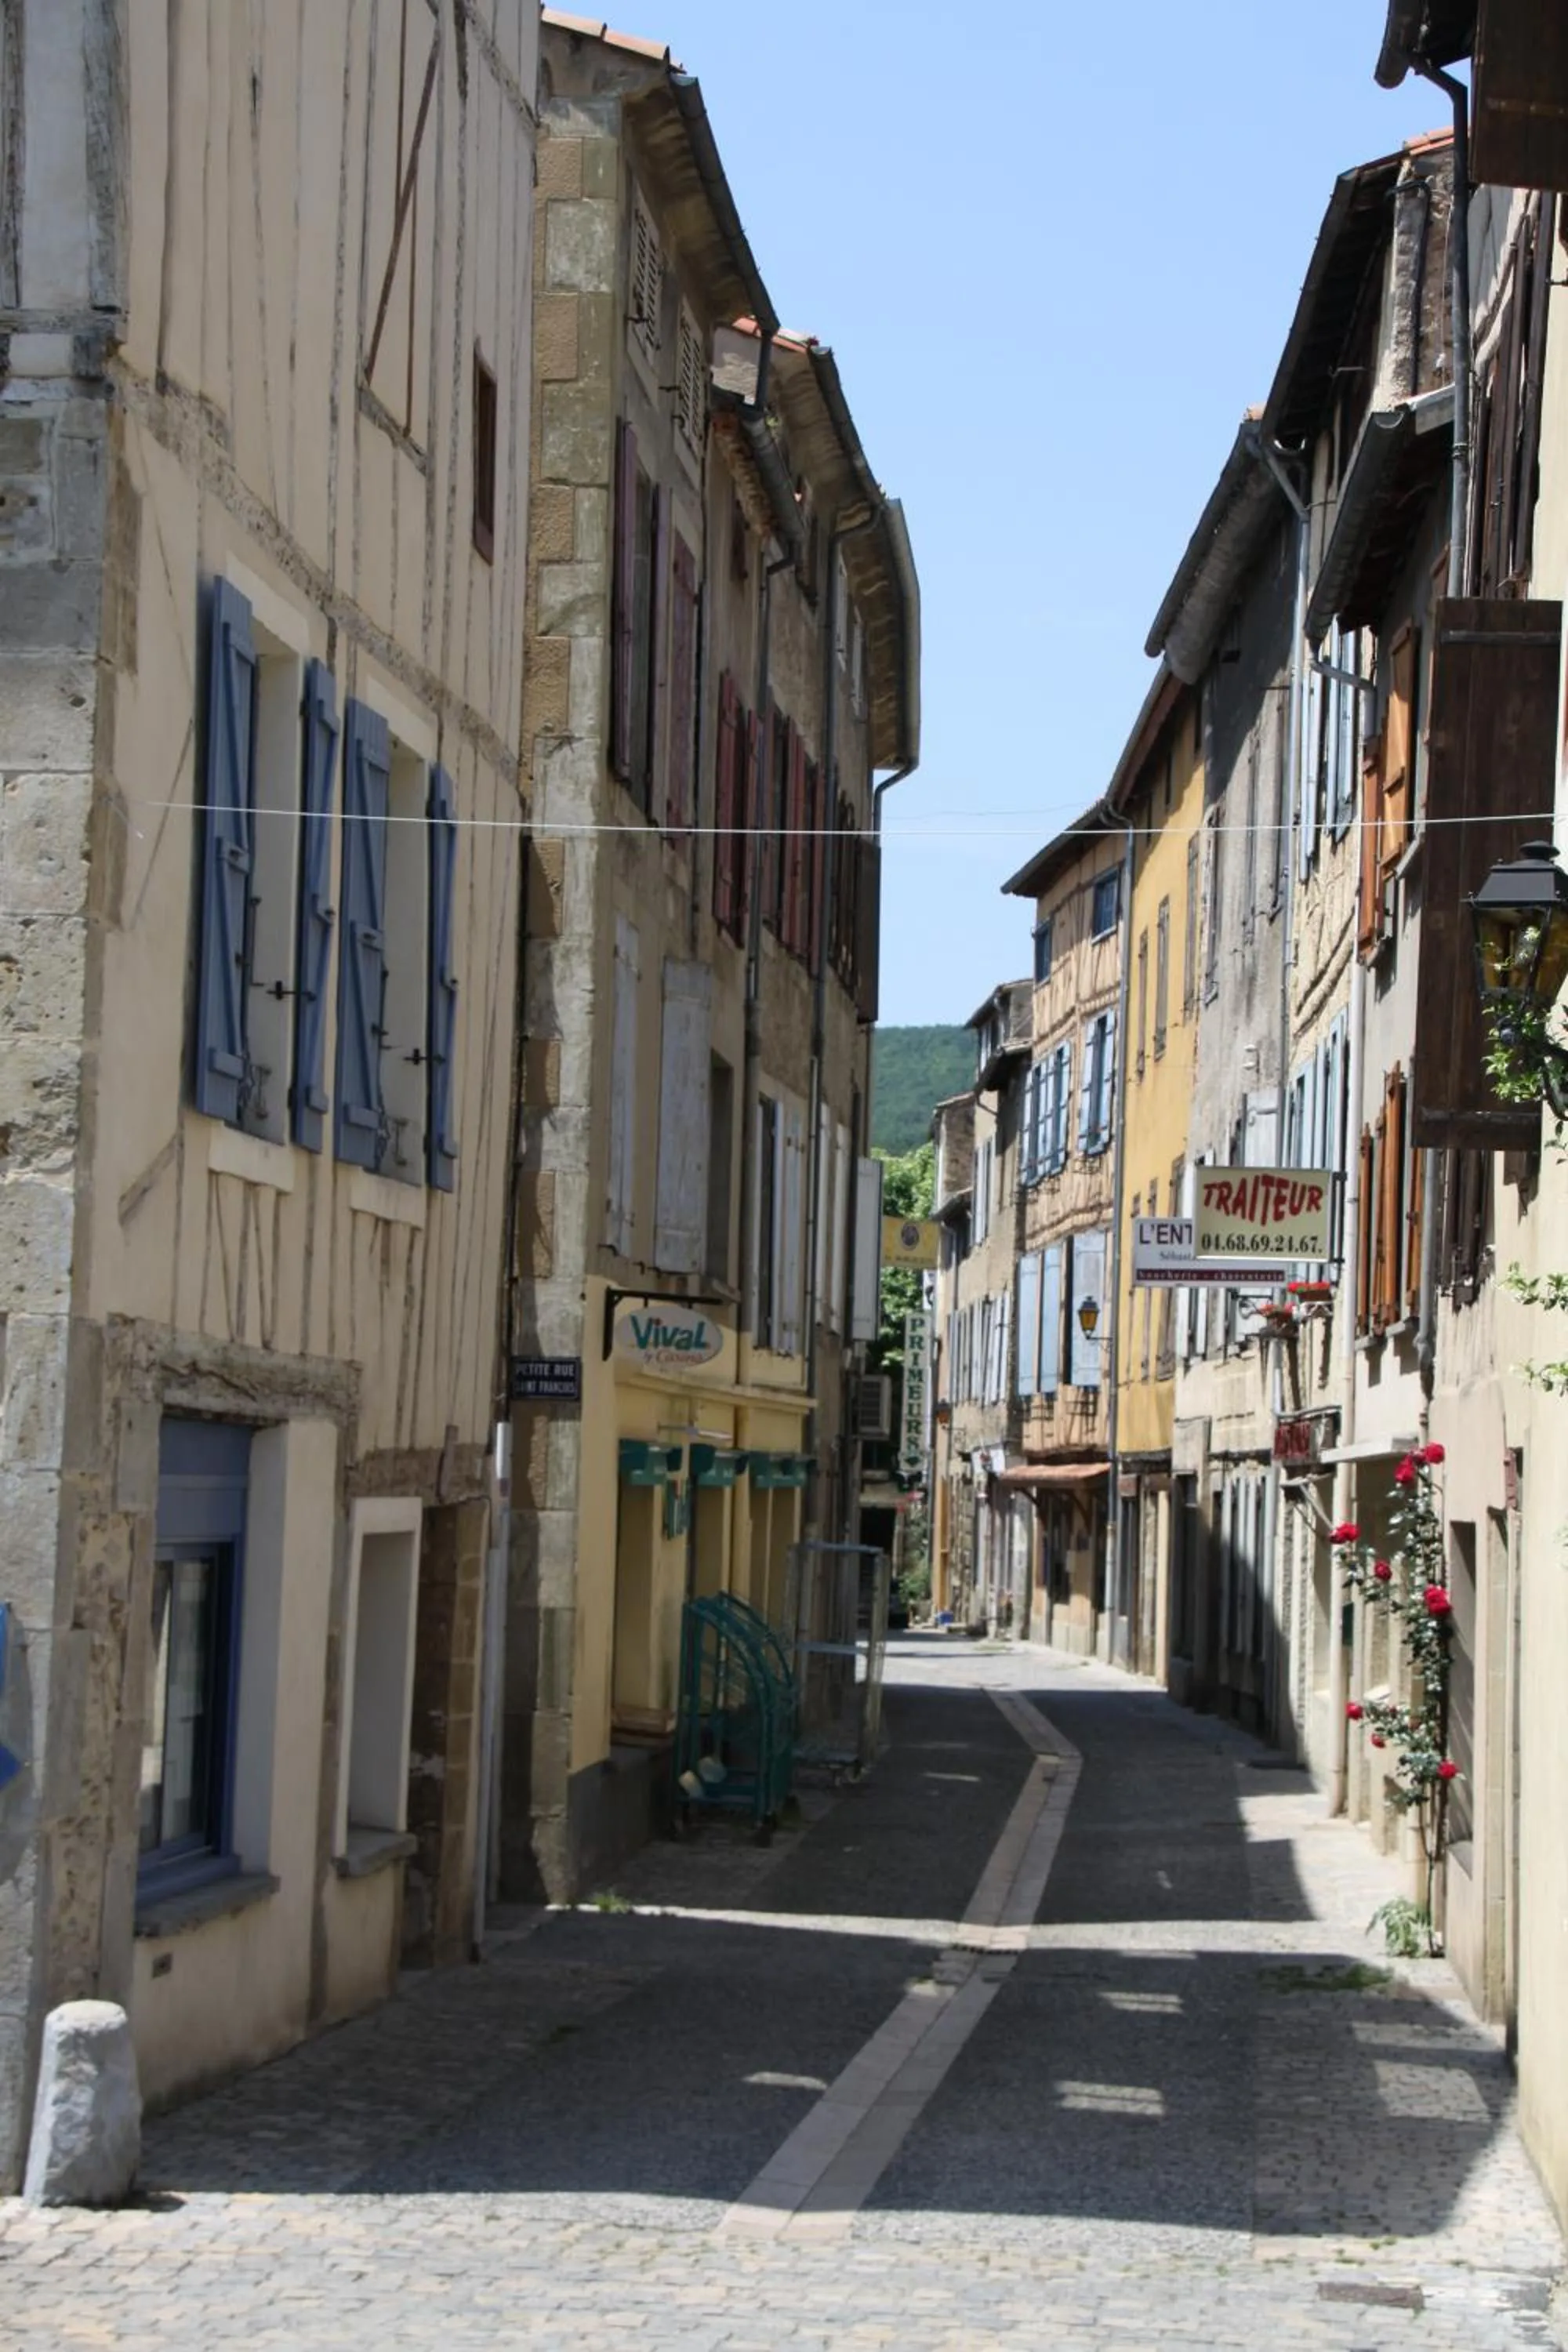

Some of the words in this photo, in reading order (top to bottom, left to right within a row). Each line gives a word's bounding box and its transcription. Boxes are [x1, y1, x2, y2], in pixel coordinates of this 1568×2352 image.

[1203, 1174, 1323, 1227] TRAITEUR
[554, 1364, 574, 1377] RUE
[906, 1318, 925, 1452] PRIMEURS
